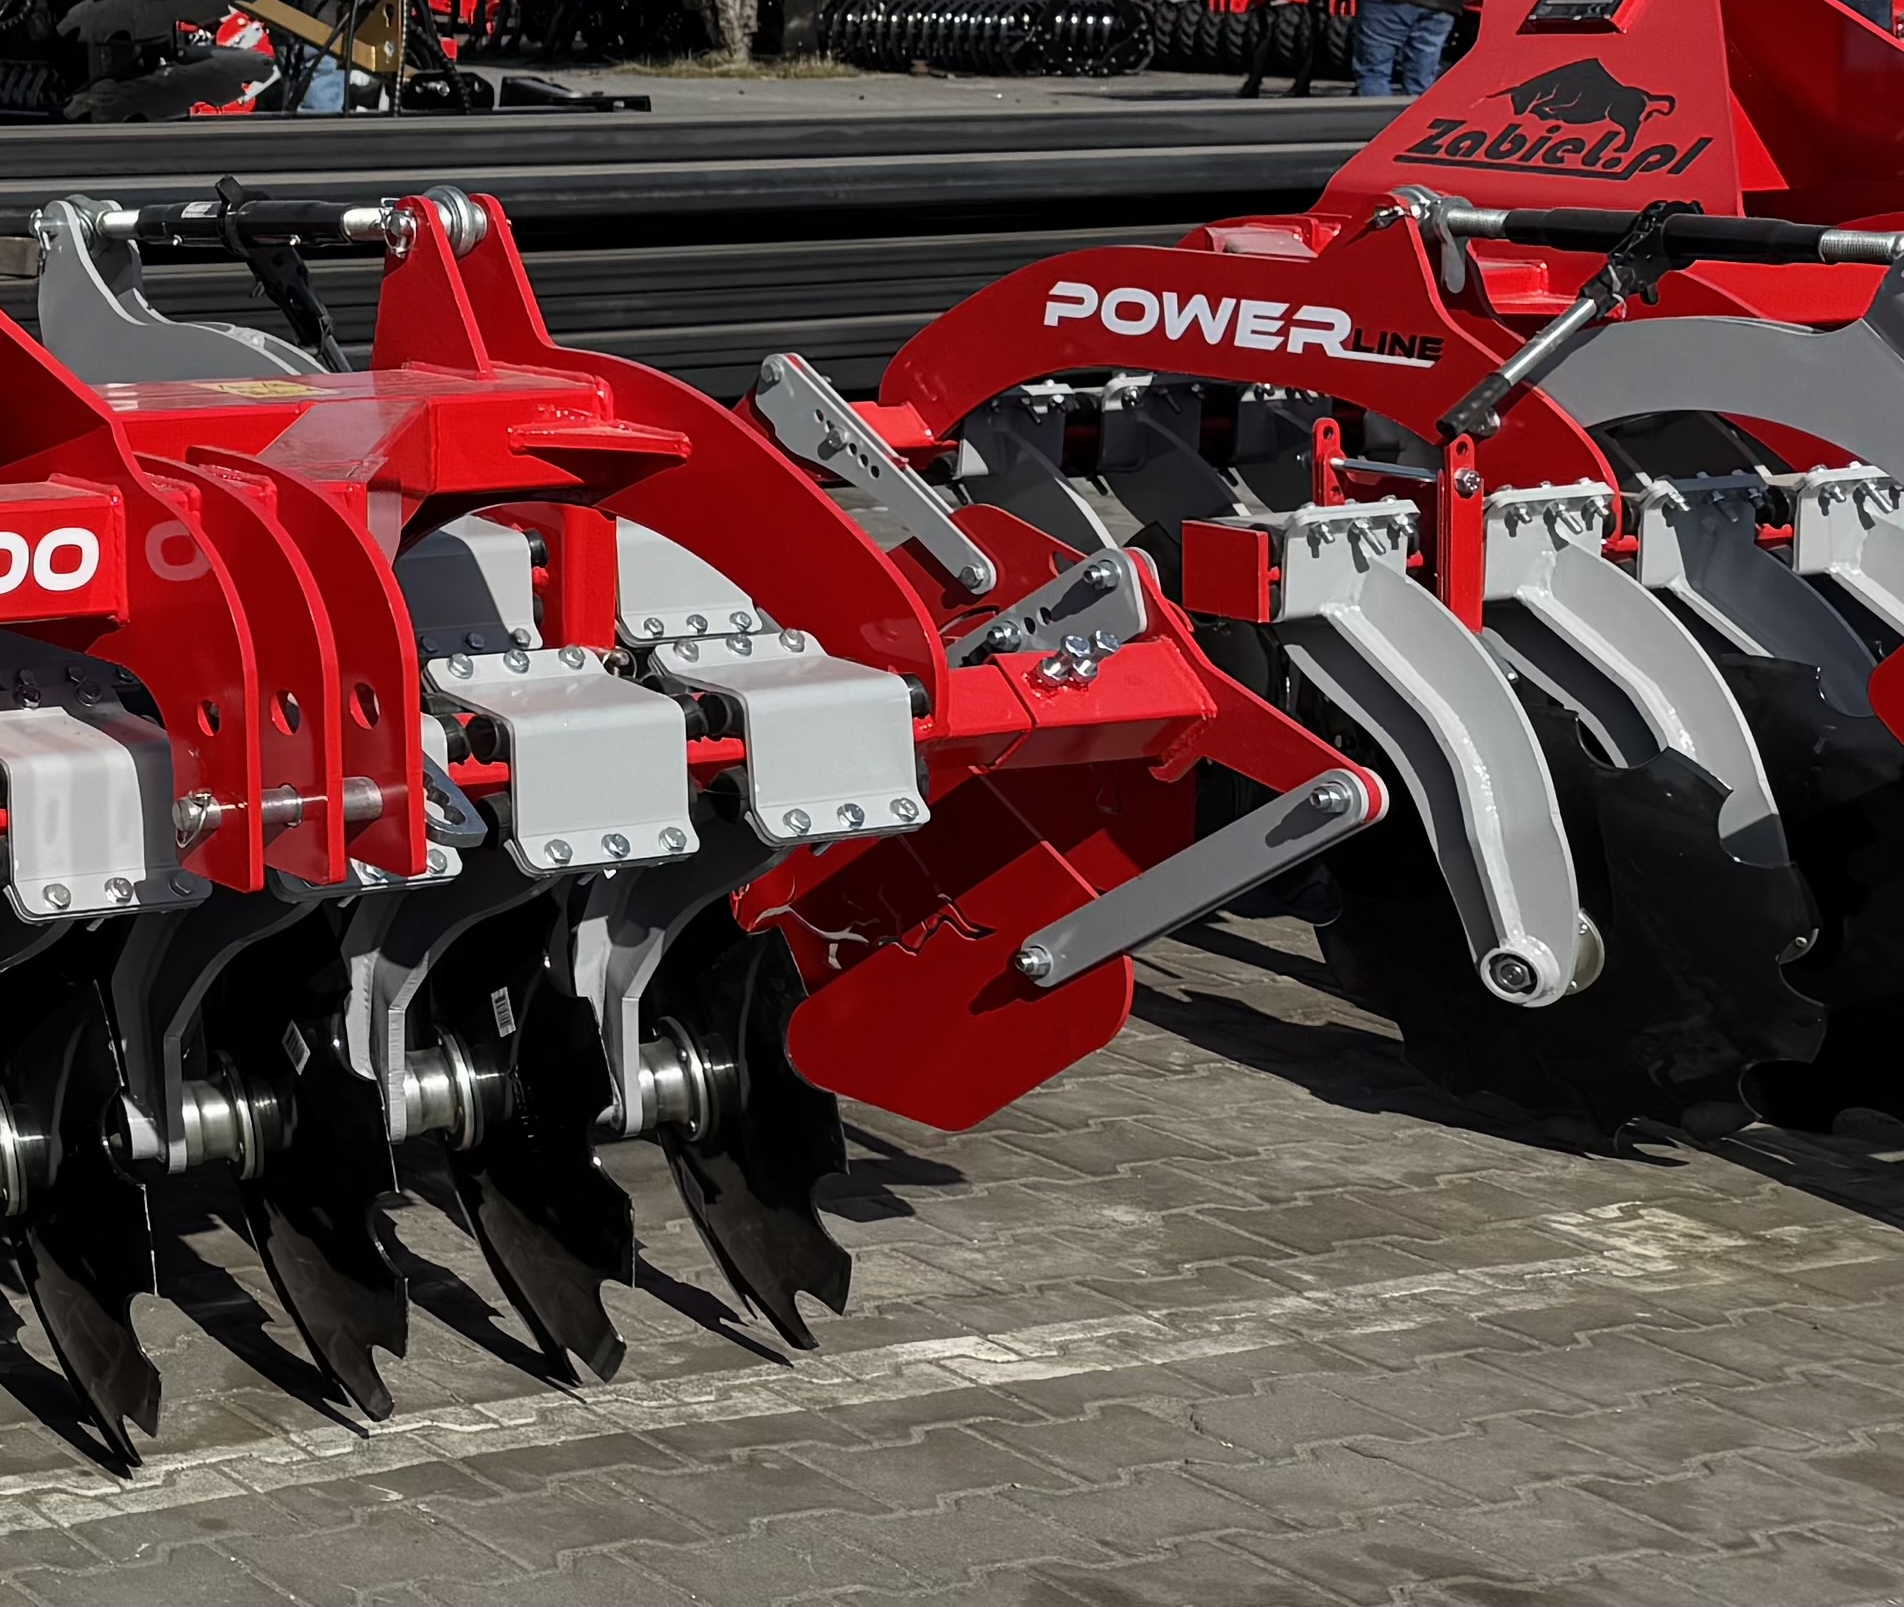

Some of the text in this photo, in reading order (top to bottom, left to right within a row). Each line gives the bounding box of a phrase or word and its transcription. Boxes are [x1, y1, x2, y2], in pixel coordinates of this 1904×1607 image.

[1405, 118, 1714, 181] Zabiel.pl
[1044, 280, 1446, 362] POWER LINE
